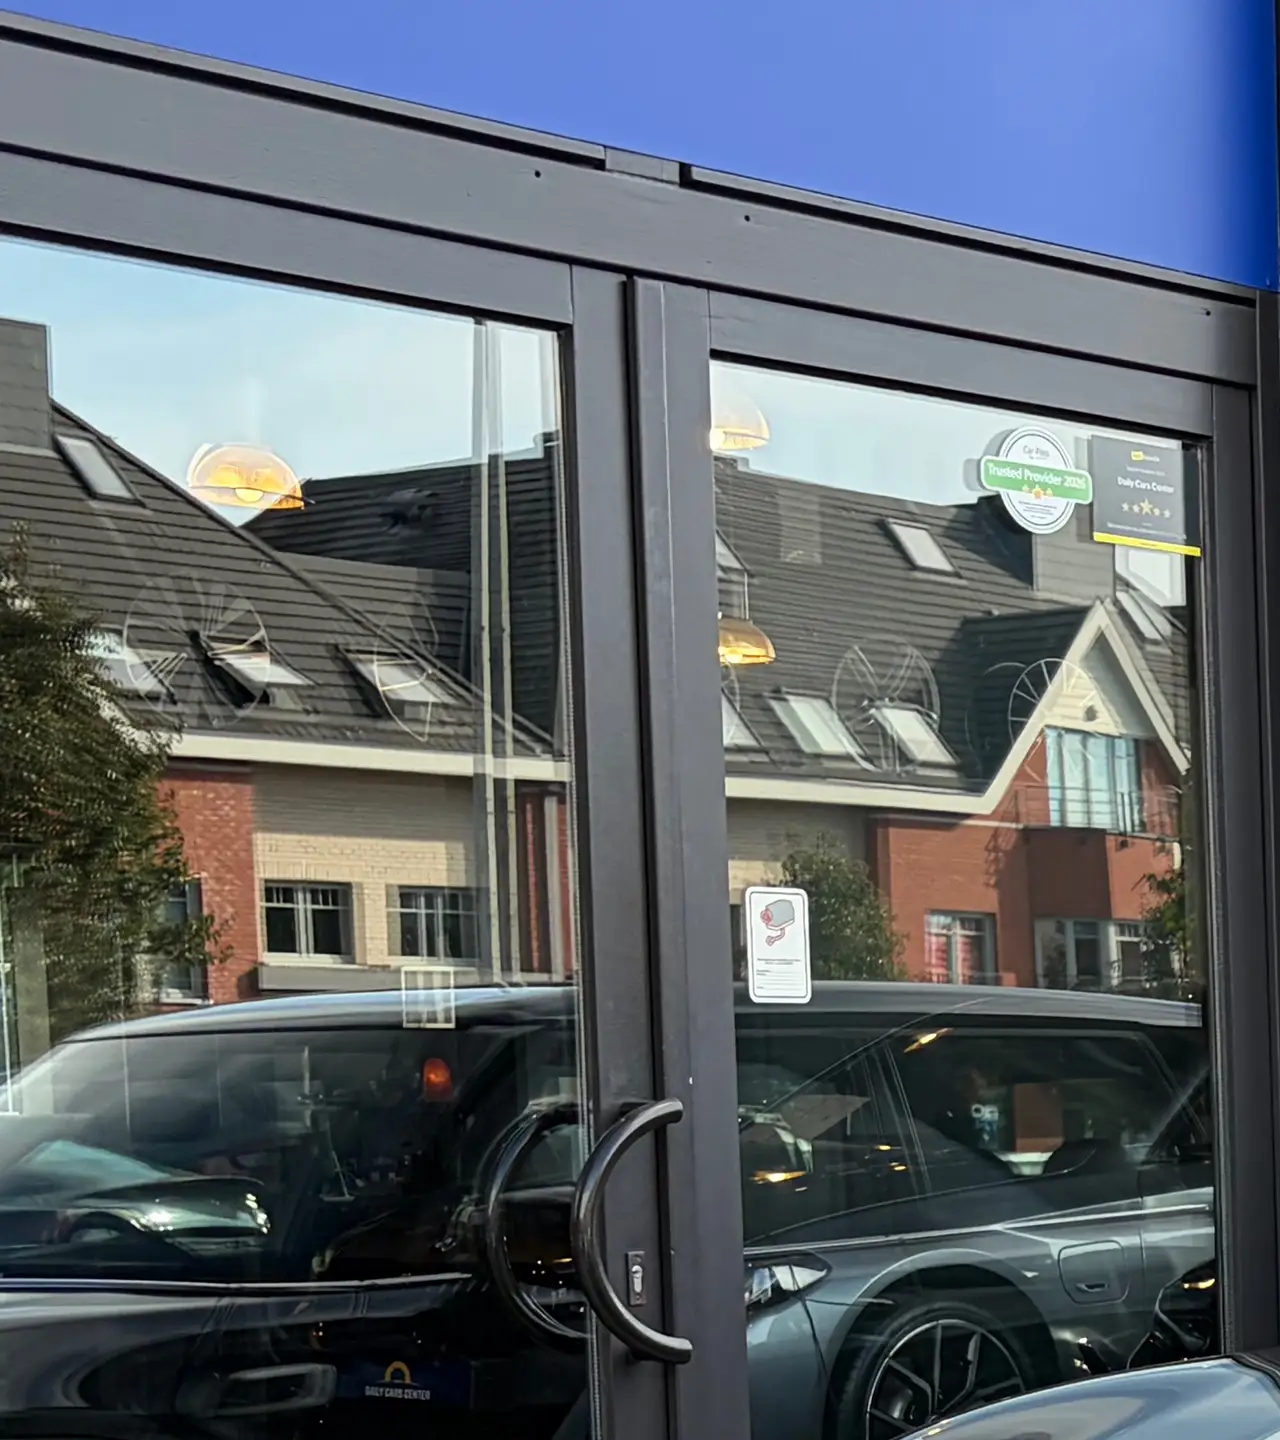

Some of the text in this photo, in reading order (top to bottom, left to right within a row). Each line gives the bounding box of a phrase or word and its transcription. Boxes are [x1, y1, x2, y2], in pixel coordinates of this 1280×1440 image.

[986, 462, 1022, 480] Trusted
[1024, 468, 1061, 486] Provider
[1117, 476, 1134, 489] Daily
[1134, 480, 1151, 490] Cars
